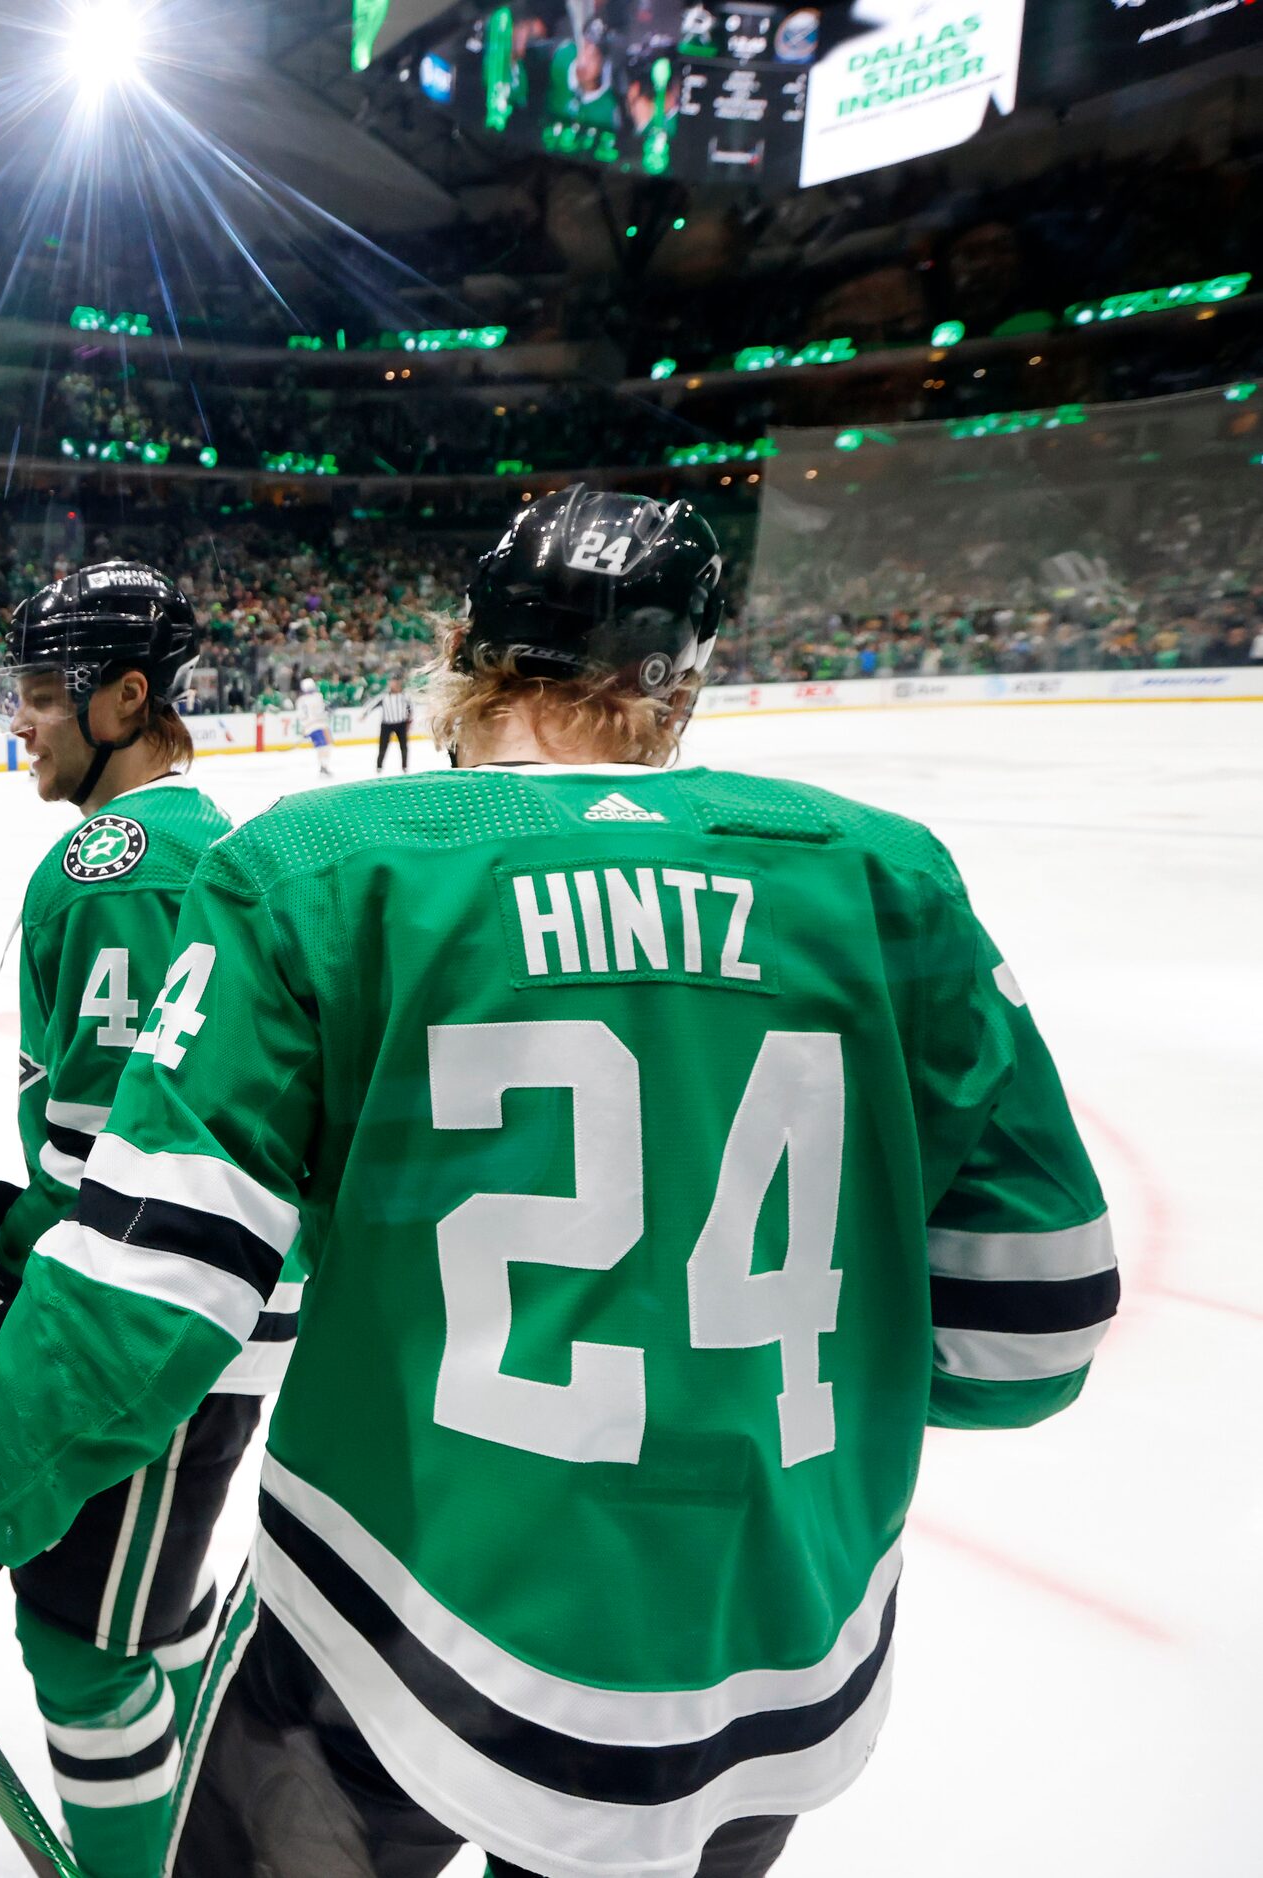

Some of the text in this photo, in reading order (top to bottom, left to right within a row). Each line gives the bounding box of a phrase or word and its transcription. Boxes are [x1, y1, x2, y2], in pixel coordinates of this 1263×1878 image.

[849, 14, 981, 73] DALLAS
[862, 41, 968, 86] STARS
[837, 56, 985, 117] INSIDER
[571, 530, 633, 573] 24
[69, 818, 139, 854] DALLAS
[584, 808, 665, 821] adidas
[71, 851, 136, 877] STARS
[512, 867, 762, 982] HINTZ
[79, 947, 139, 1049] 4
[427, 1019, 844, 1469] 24
